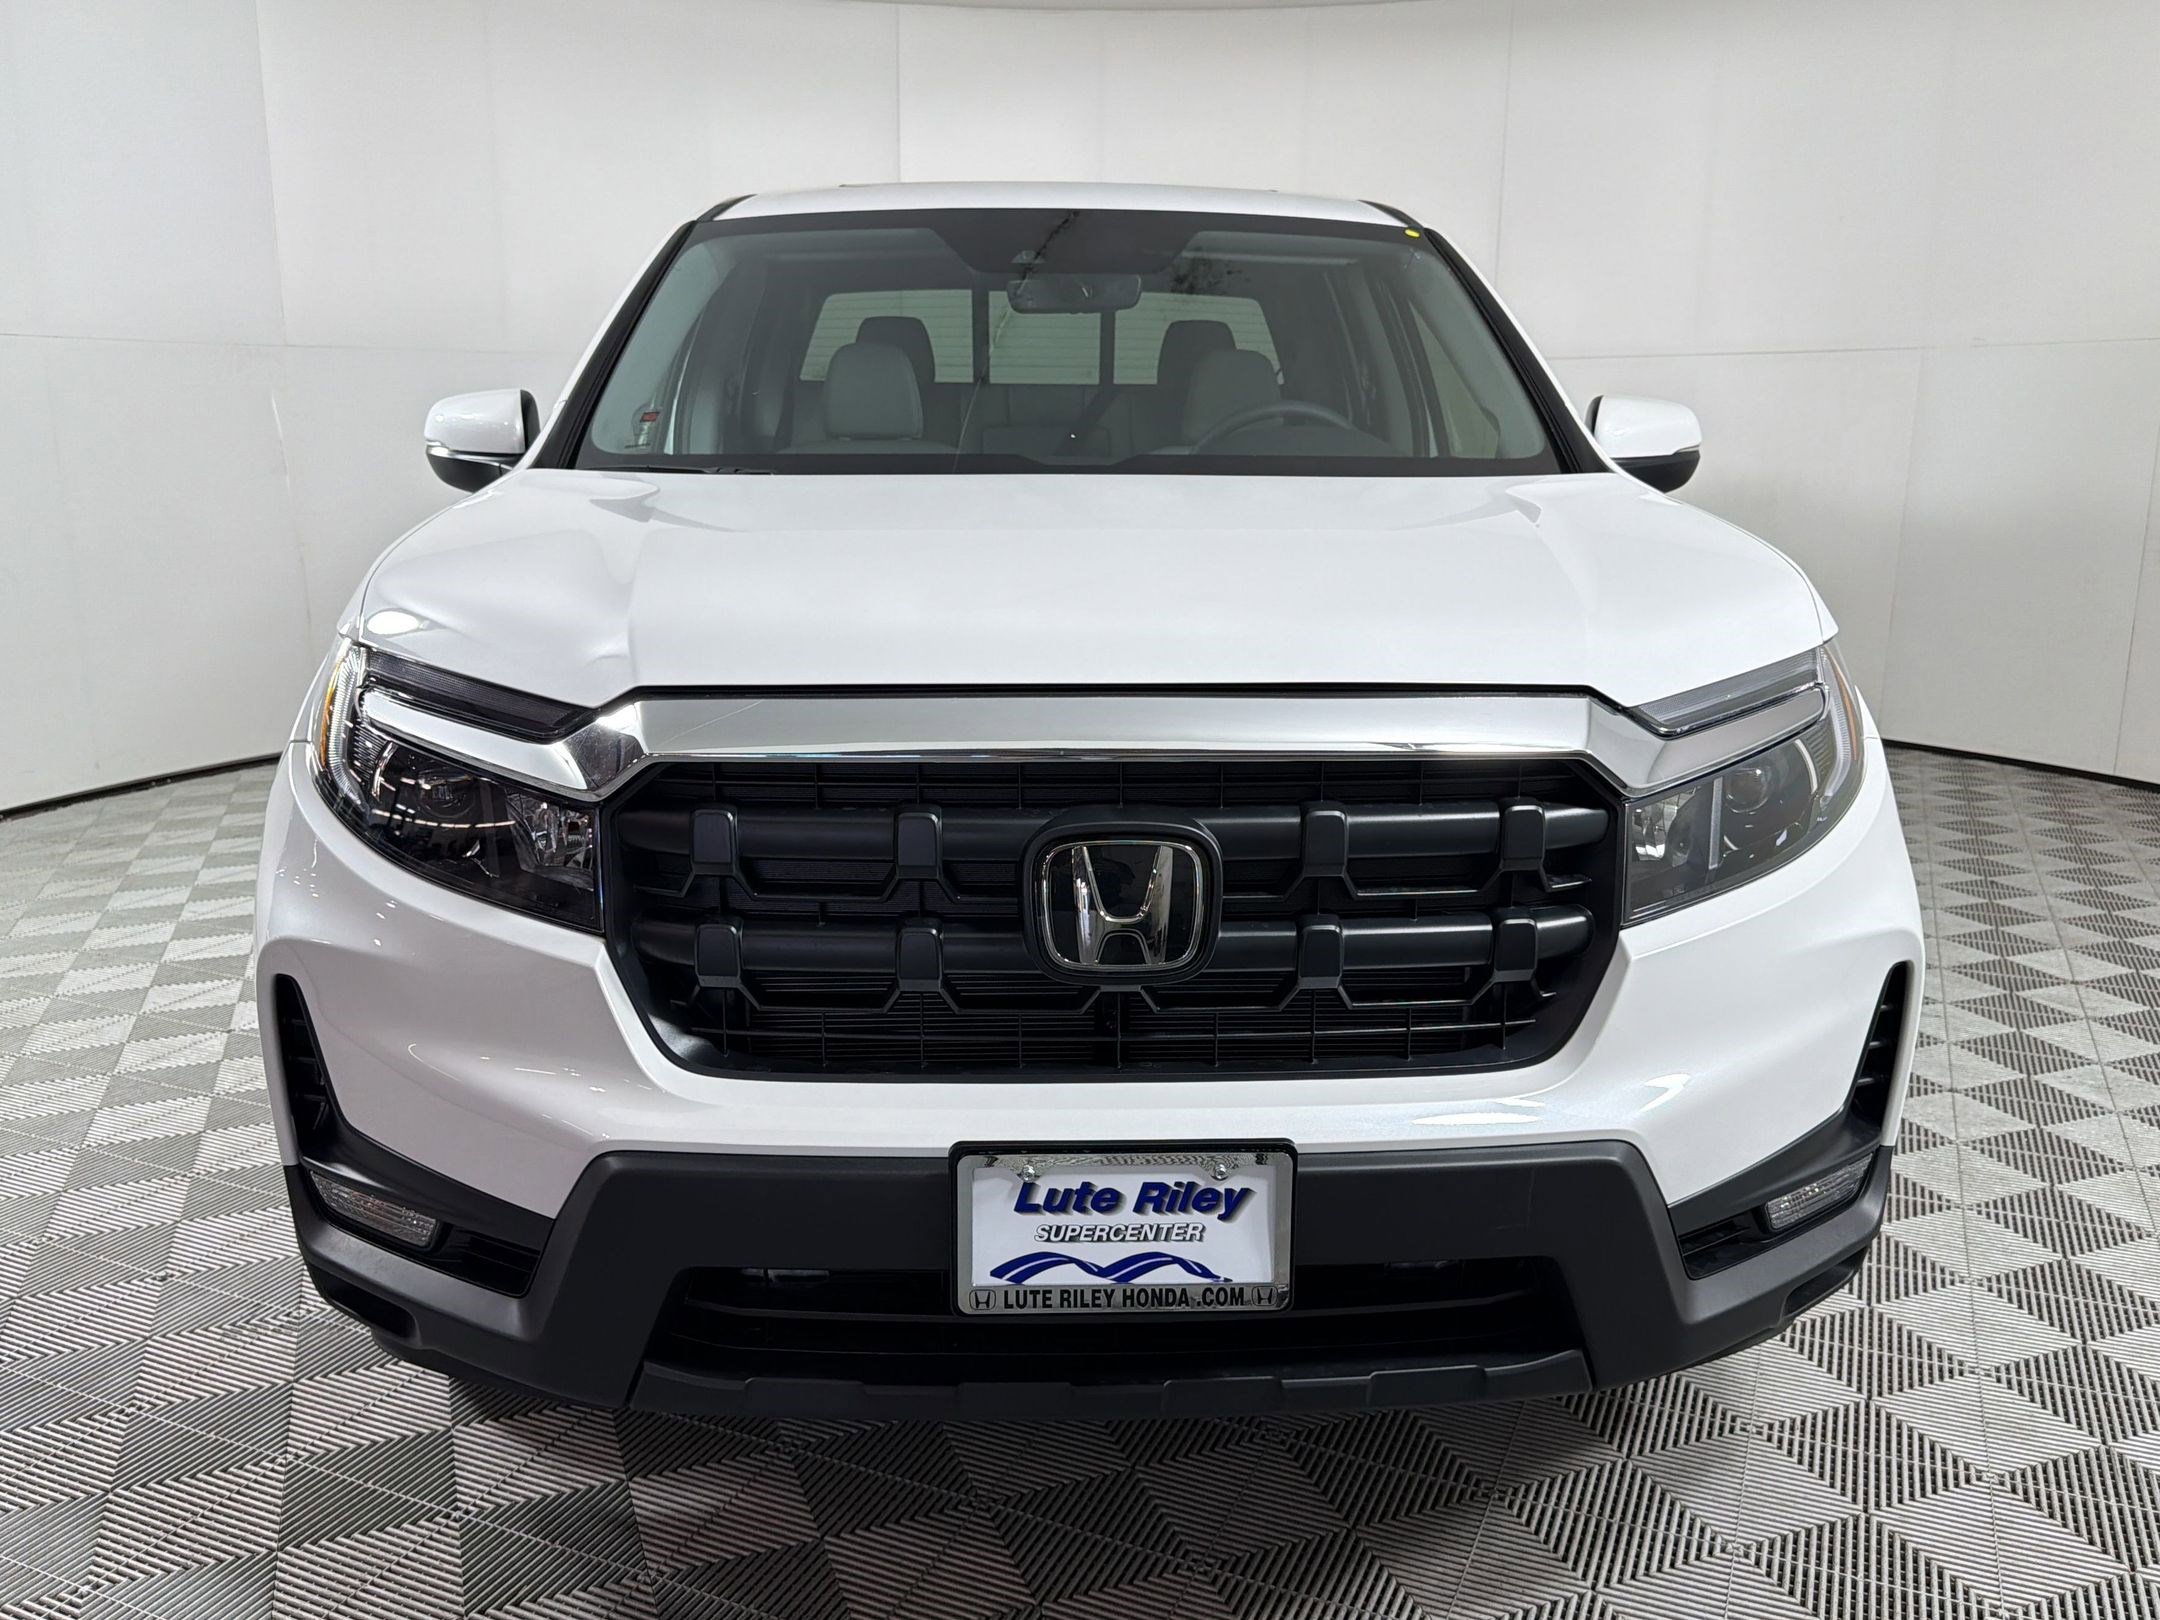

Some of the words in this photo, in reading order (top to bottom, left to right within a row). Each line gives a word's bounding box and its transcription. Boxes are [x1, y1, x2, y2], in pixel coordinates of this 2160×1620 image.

[1014, 1181, 1125, 1214] Lute
[1132, 1181, 1256, 1222] Riley
[1034, 1222, 1206, 1242] SUPERCENTER
[1003, 1288, 1053, 1310] LUTE
[1059, 1288, 1116, 1309] RILEY
[1122, 1287, 1190, 1308] HONDA
